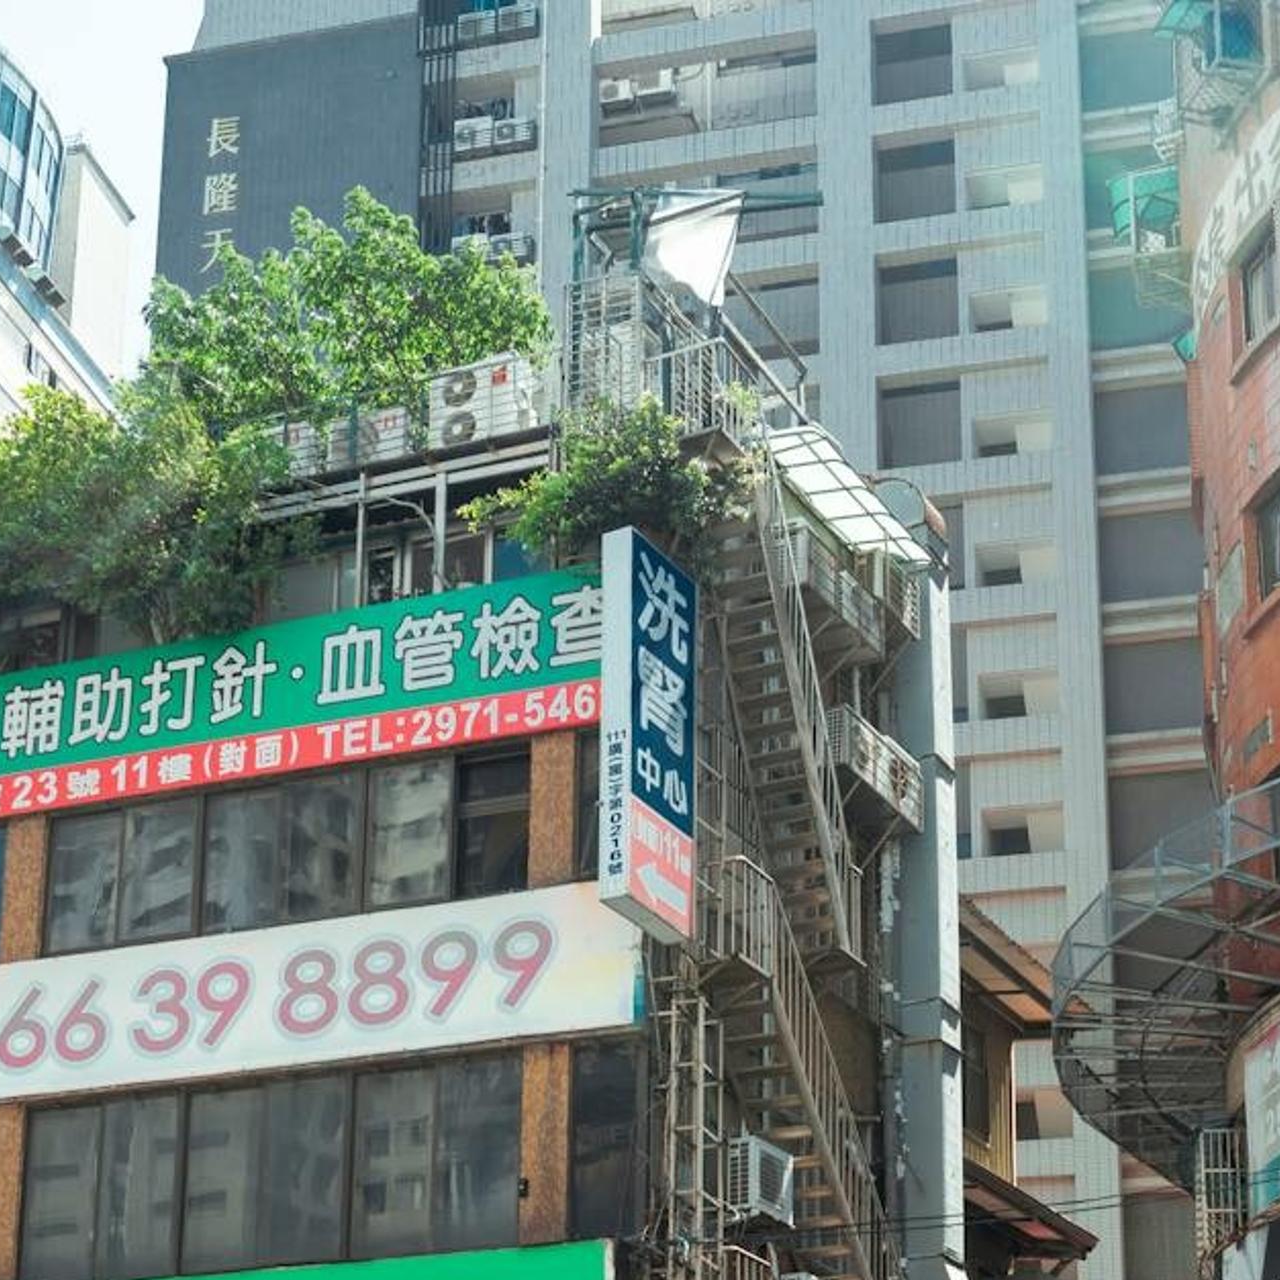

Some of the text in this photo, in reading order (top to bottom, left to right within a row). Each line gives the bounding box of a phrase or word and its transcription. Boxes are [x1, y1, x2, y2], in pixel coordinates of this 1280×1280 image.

[318, 692, 603, 760] TEL:2971-546
[130, 959, 252, 1056] 39
[276, 919, 557, 1040] 8899
